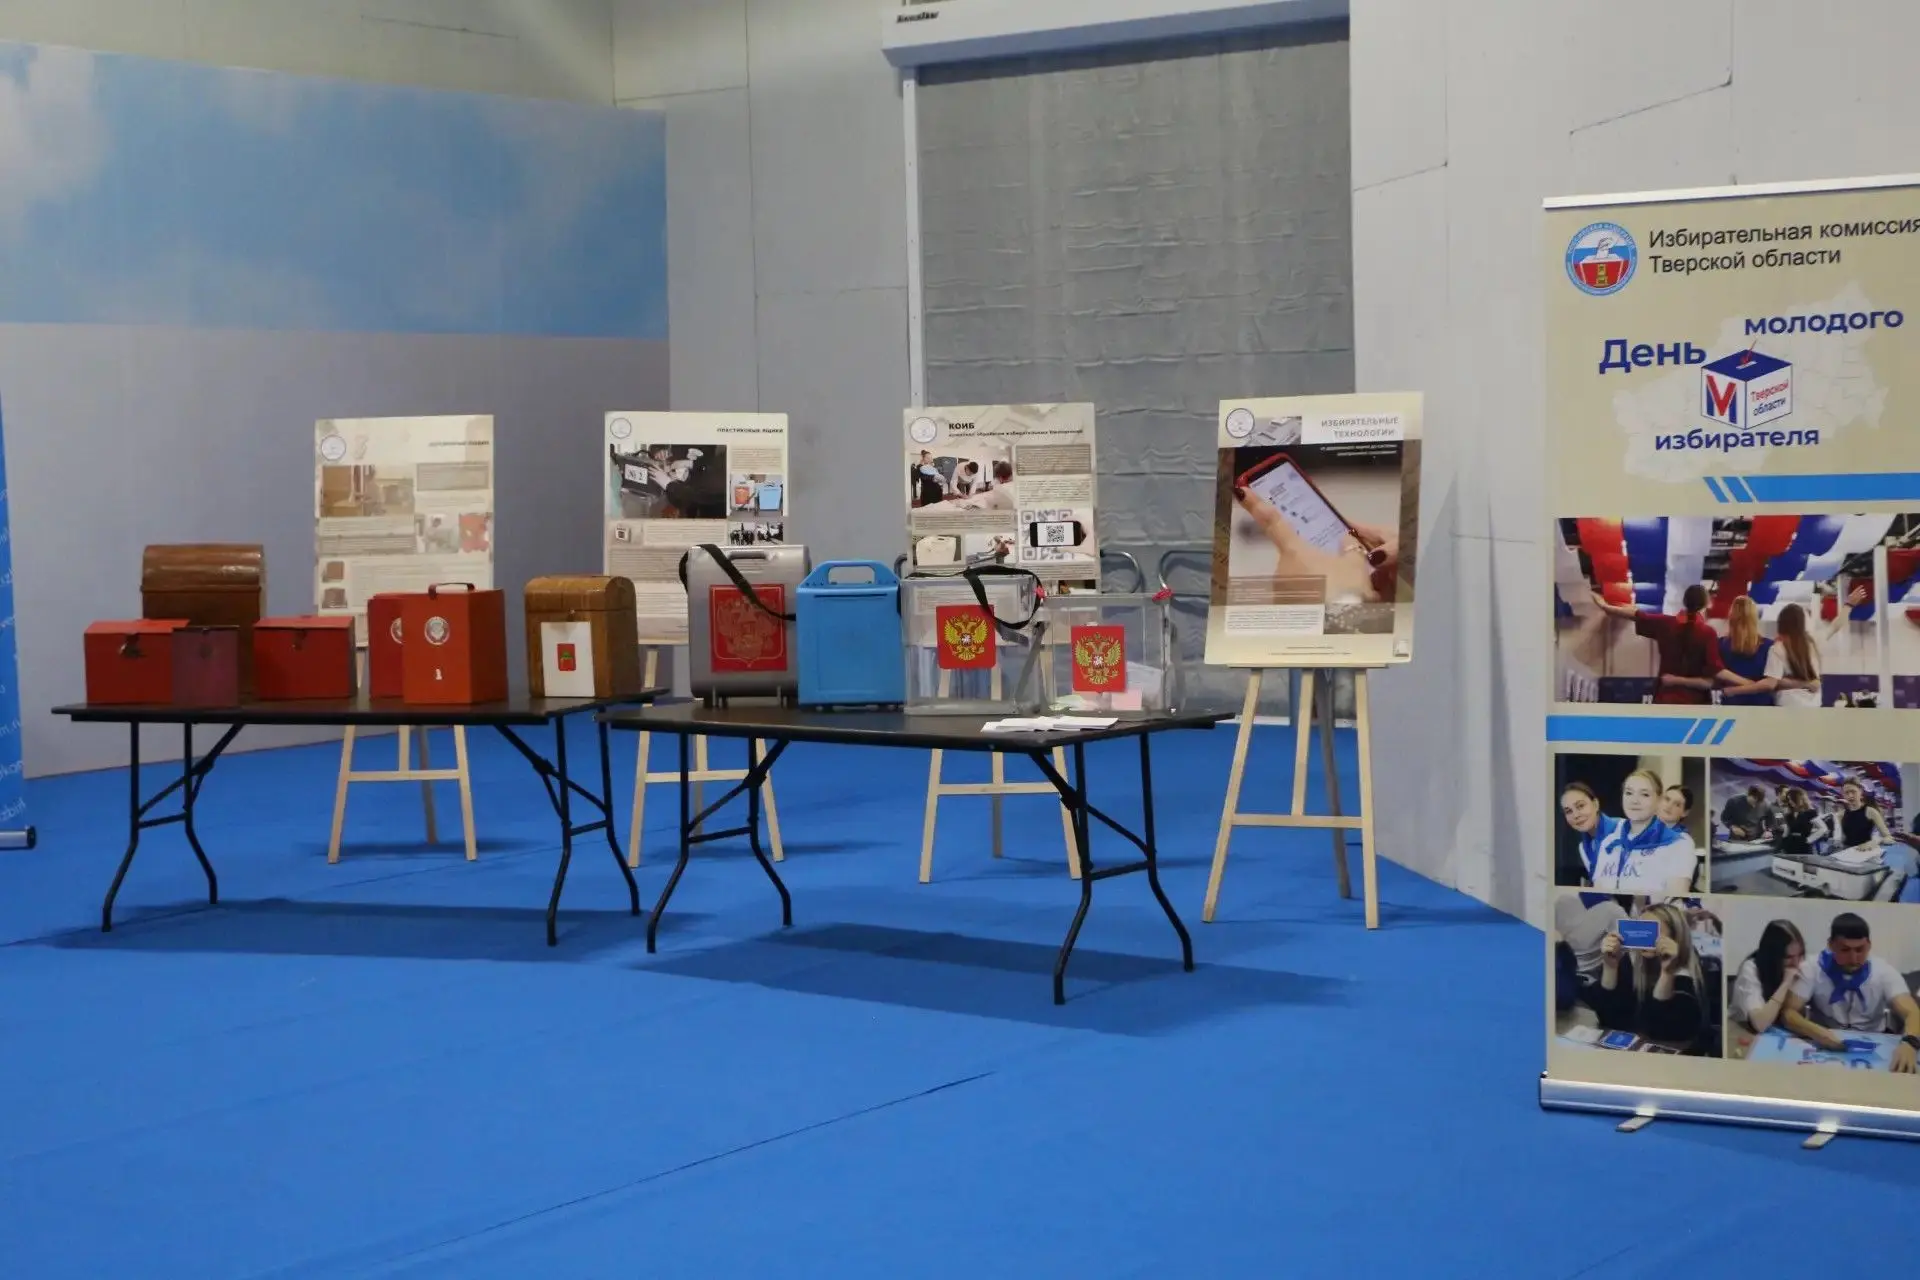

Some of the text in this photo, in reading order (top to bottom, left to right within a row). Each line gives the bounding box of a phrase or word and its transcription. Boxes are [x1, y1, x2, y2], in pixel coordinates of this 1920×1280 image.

[1649, 219, 1920, 249] Избирательная комиссия
[1649, 248, 1841, 275] Тверской области
[1745, 309, 1904, 335] молодого
[1599, 339, 1707, 374] День
[1750, 379, 1788, 402] Тверской
[1753, 397, 1786, 416] области
[949, 422, 975, 430] КОИБ
[1321, 417, 1399, 427] ИЗБИРАТЕЛЬНЫЕ
[1334, 429, 1394, 438] ТЕХНОЛОГИИ
[1655, 428, 1820, 453] избирателя
